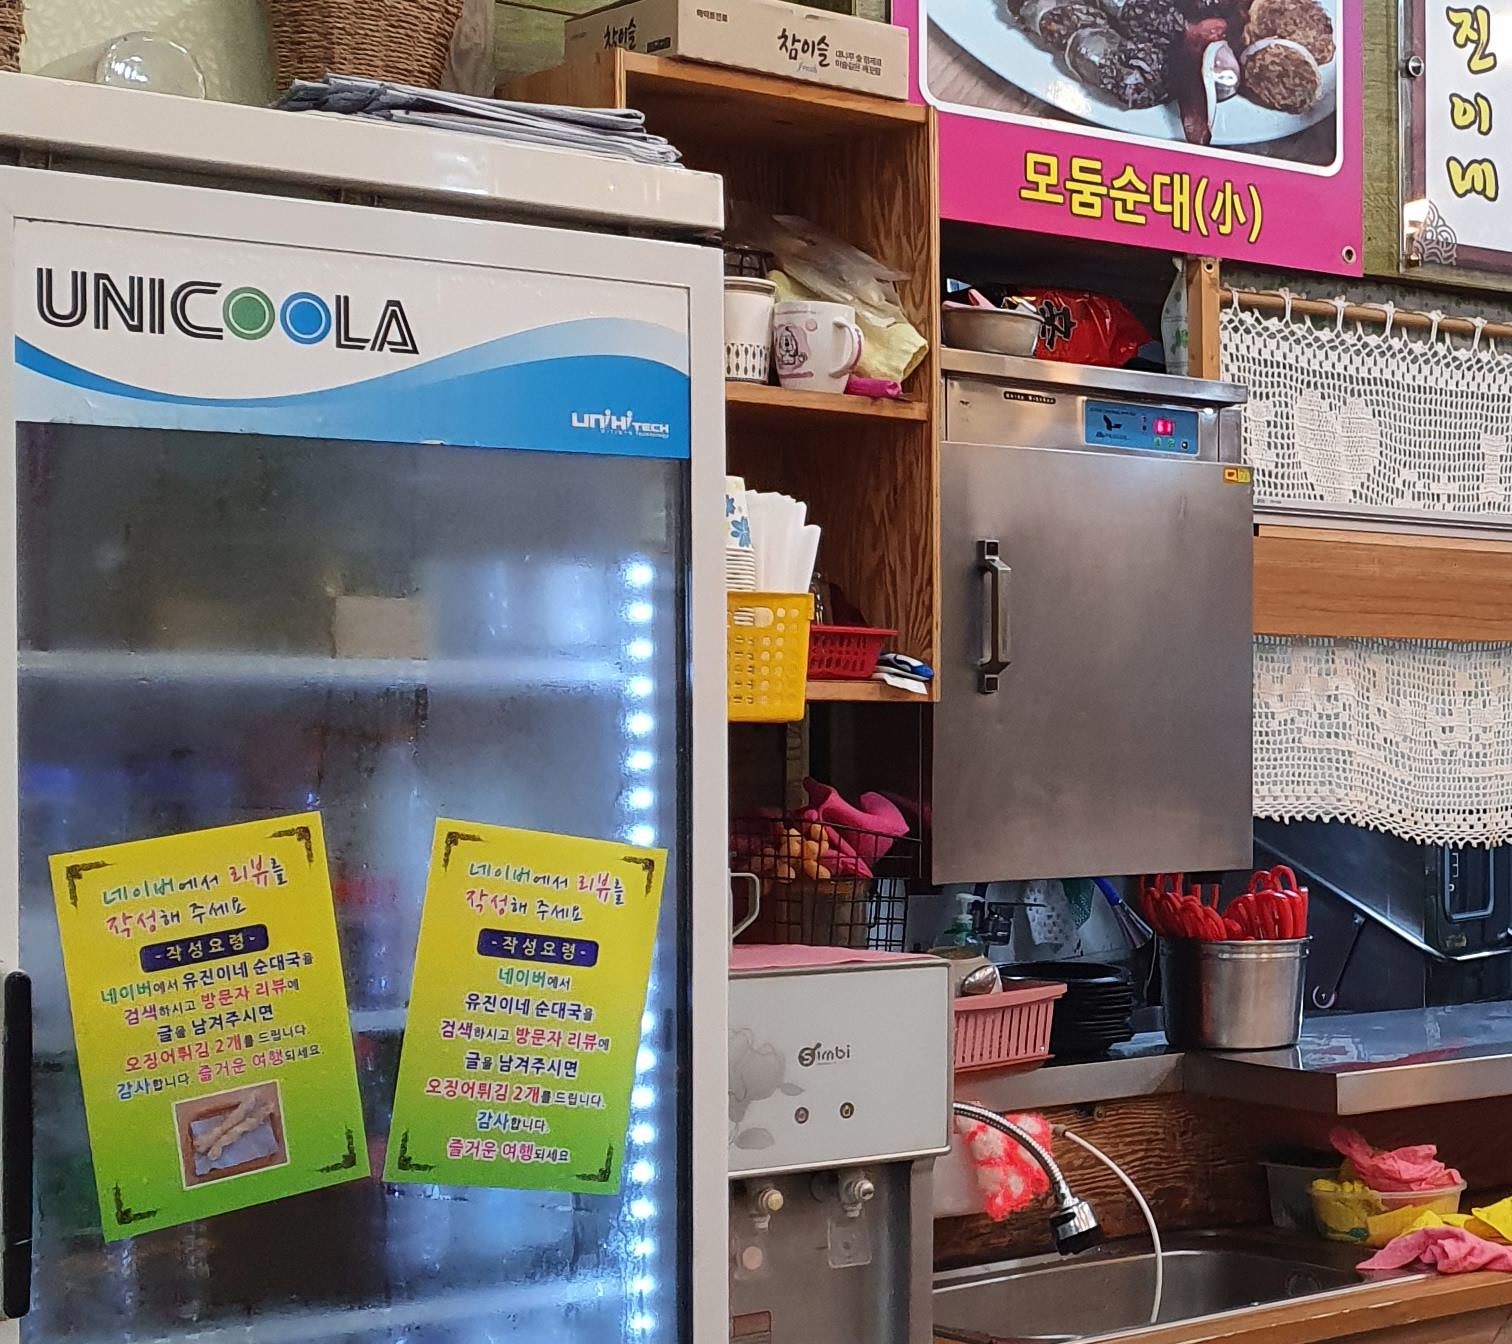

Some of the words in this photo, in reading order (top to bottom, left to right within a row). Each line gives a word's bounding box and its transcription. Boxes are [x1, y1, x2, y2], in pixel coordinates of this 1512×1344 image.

[777, 27, 831, 68] 참이슬
[103, 874, 220, 906] 네이버에서
[228, 855, 288, 888] 리뷰를
[469, 863, 568, 889] 네이버에서
[578, 873, 624, 905] 리뷰를
[106, 909, 181, 939] 작성해
[189, 896, 247, 925] 주세요
[466, 888, 527, 916] 작성해
[536, 899, 584, 921] 주세요
[101, 977, 180, 1005] 네이버에서
[182, 962, 248, 990] 유진이네
[253, 952, 314, 976] 순대국을
[498, 967, 571, 992] 네이버에서
[124, 1000, 197, 1027] 검색하시고
[201, 985, 250, 1010] 방문자
[255, 978, 300, 998] 리뷰에
[465, 992, 531, 1016] 유진이네
[535, 999, 594, 1022] 순대국을
[157, 1023, 187, 1044] 글을
[192, 1003, 274, 1036] 남겨주시면
[441, 1019, 510, 1043] 검색하시고
[515, 1026, 562, 1048] 방문자
[567, 1032, 610, 1051] 리뷰에
[125, 1040, 210, 1073] 오징어튀김
[197, 1056, 247, 1083] 즐거운
[465, 1051, 493, 1070] 글을
[499, 1053, 578, 1079] 남겨주시면
[426, 1078, 509, 1102] 오징어튀김
[513, 1085, 551, 1105] 2개를
[448, 1138, 497, 1160] 즐거운
[502, 1142, 569, 1163] 여행되세요
